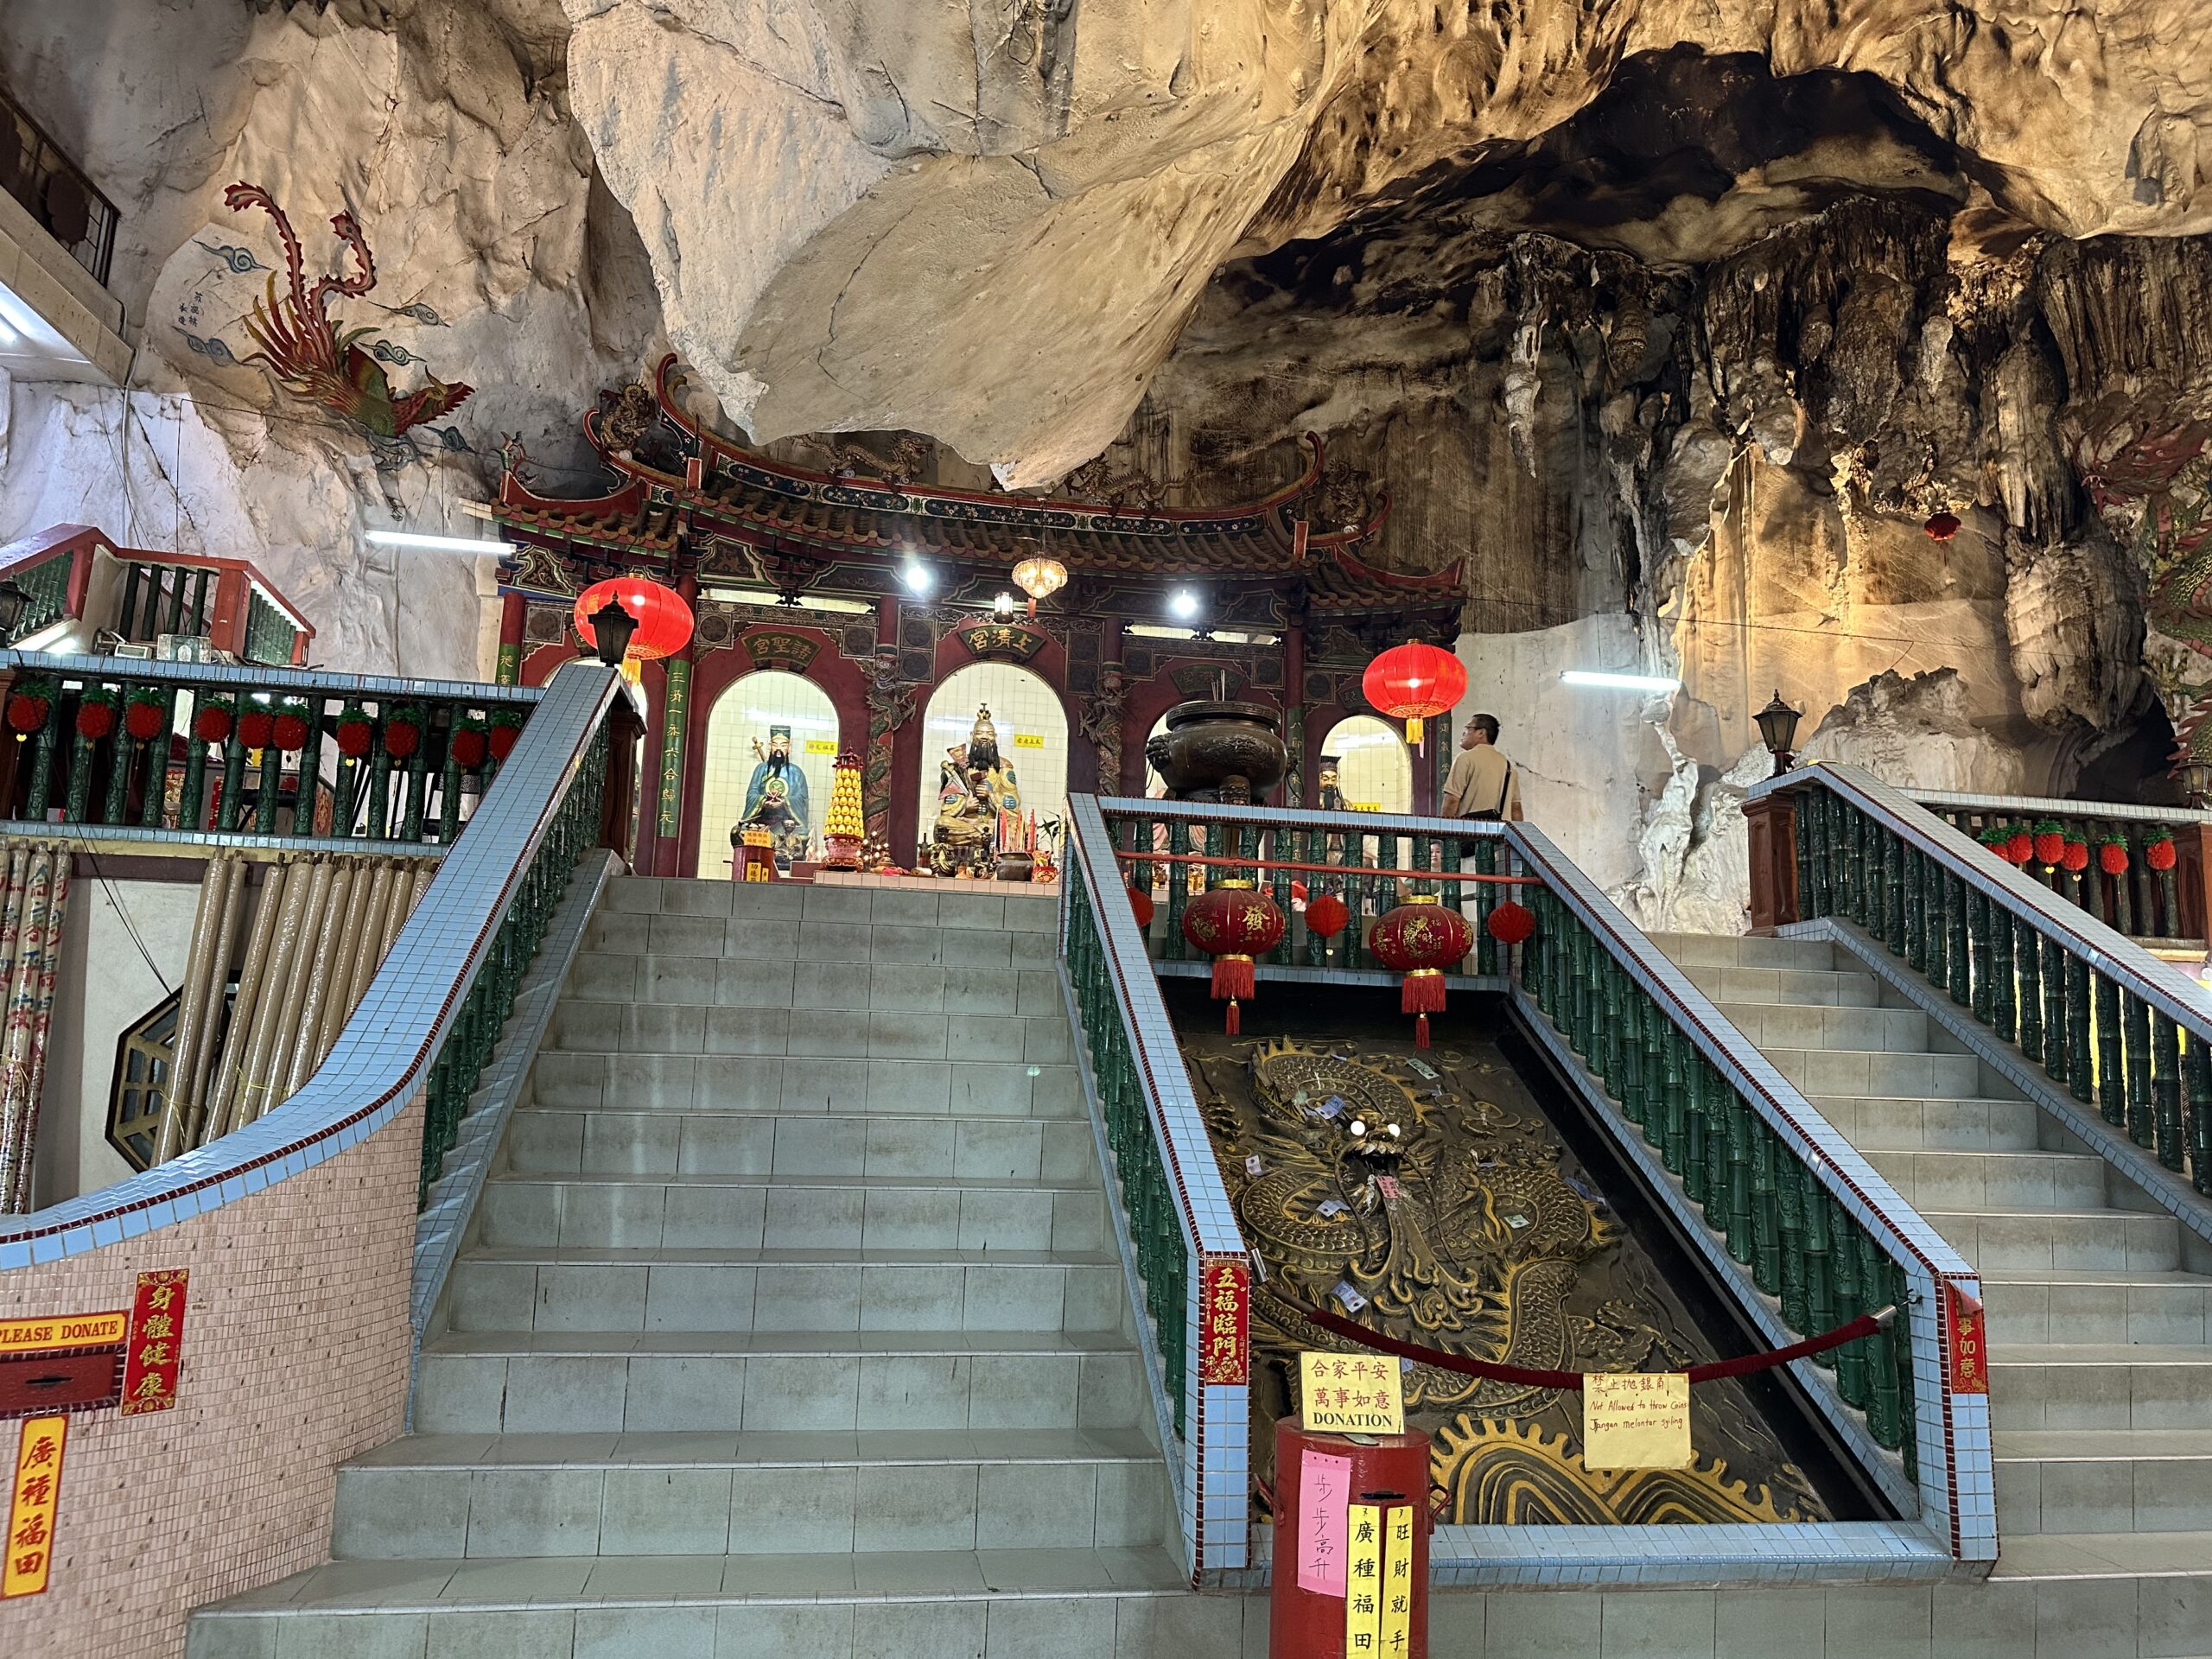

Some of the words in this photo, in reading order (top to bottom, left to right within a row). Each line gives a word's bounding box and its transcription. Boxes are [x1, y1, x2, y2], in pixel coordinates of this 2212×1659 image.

[753, 636, 811, 660] 諸聖宮
[969, 627, 1033, 654] 上清宮
[60, 1320, 118, 1339] DONATE
[1212, 1267, 1239, 1358] 五福臨門
[133, 1286, 175, 1397] 身體健康
[1956, 1301, 1977, 1378] 事如意
[1311, 1358, 1389, 1381] 合家平安
[1313, 1386, 1390, 1409] 萬事如意
[1313, 1412, 1392, 1427] DONATION
[1590, 1401, 1603, 1411] Not
[1608, 1400, 1635, 1412] Allowed
[1637, 1400, 1646, 1409] to
[15, 1435, 57, 1575] 廣種福田
[1309, 1473, 1334, 1580] 步步高升
[1352, 1521, 1376, 1650] 廣種福田
[1389, 1523, 1410, 1652] 旺財就手
